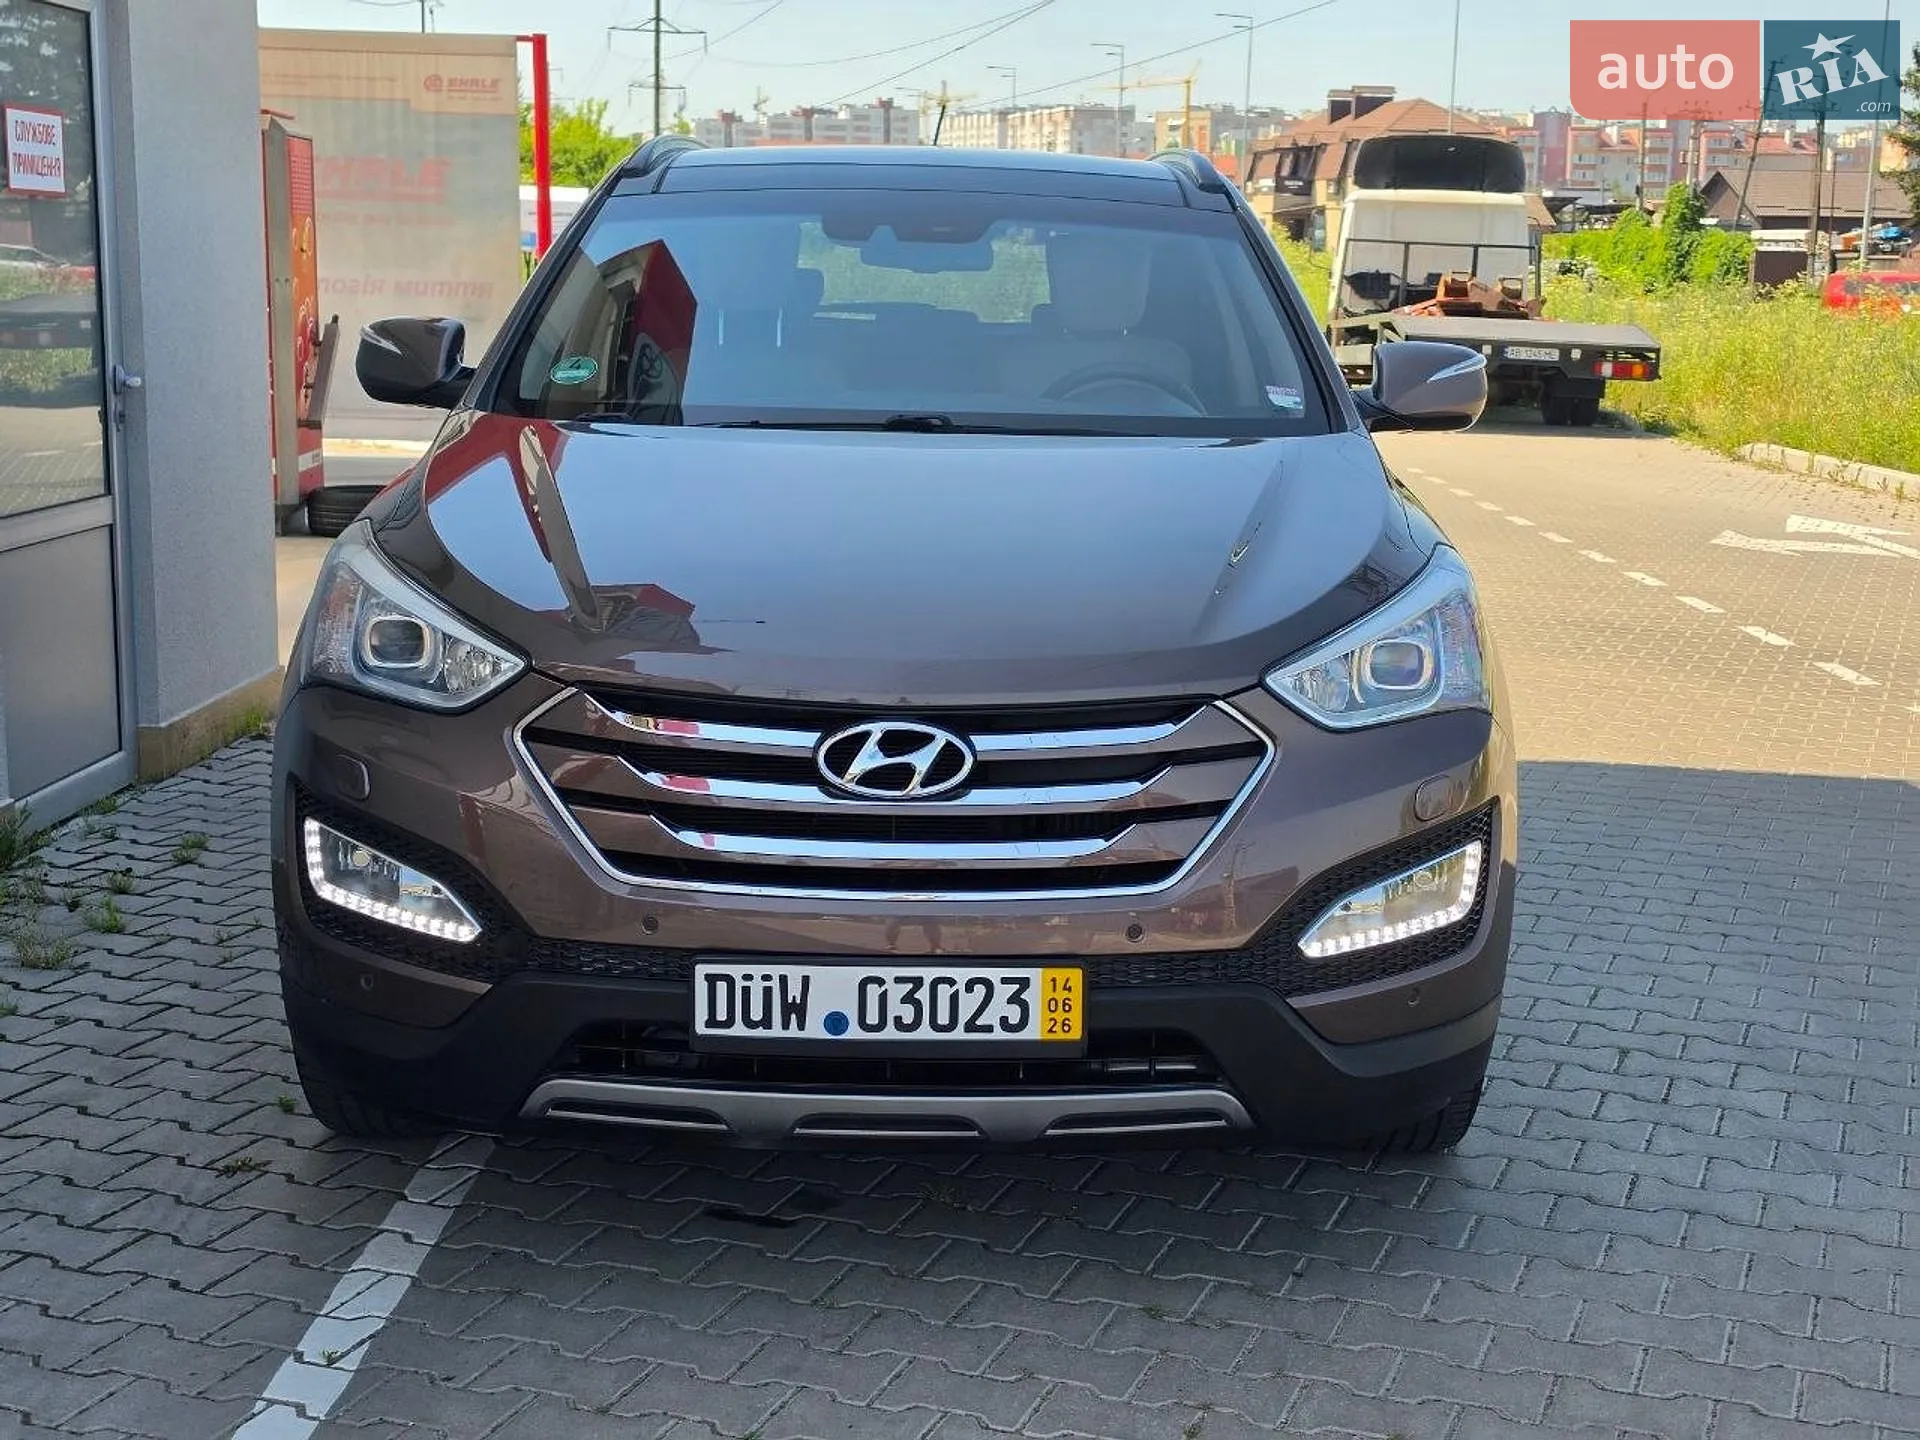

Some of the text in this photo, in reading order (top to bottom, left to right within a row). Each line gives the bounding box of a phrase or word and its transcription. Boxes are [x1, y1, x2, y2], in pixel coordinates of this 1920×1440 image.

[15, 119, 56, 146] СЛУЖБОВЕ
[12, 152, 61, 178] ПРИМІЩЕННЯ
[1049, 976, 1072, 993] 14
[857, 975, 1031, 1034] 03023
[1047, 997, 1072, 1013] 06
[1047, 1017, 1072, 1034] 26
